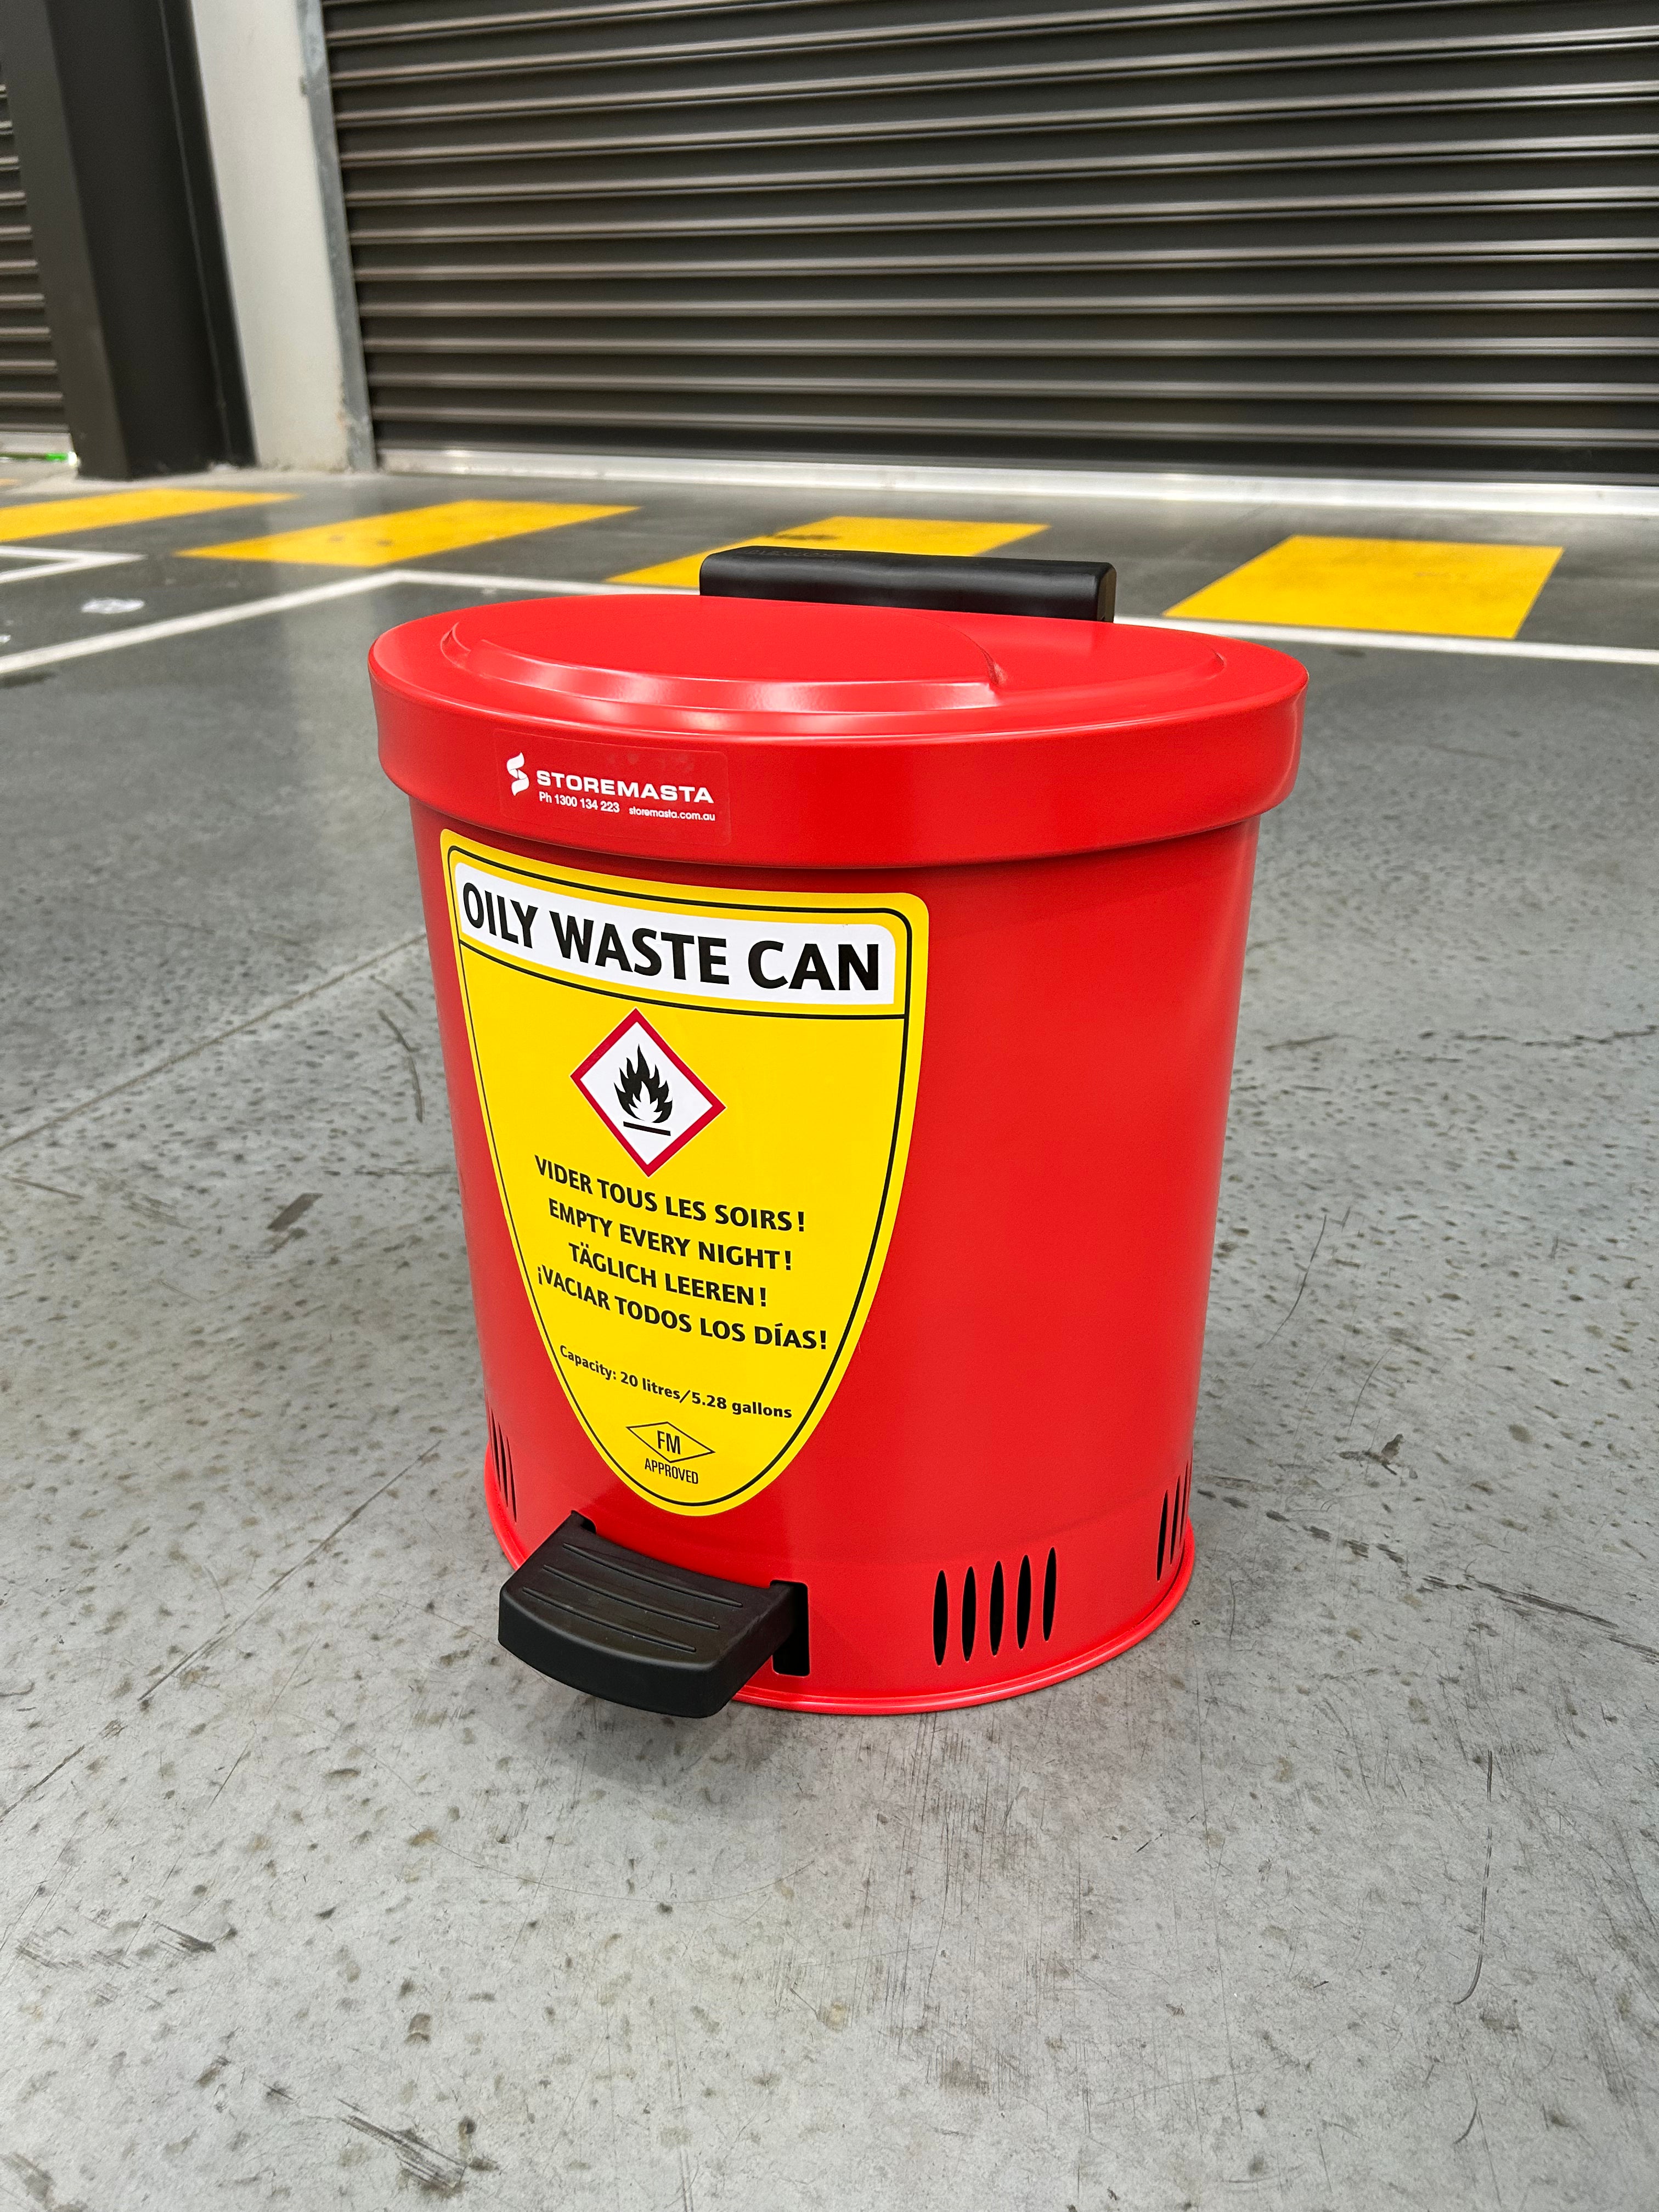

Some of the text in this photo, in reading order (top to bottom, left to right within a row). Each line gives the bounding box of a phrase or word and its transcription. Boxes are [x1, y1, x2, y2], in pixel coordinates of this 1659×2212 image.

[537, 771, 714, 803] STOREMASTA
[539, 792, 619, 812] Ph 1300 134 223
[629, 806, 715, 821] storemasta.com.au
[463, 883, 878, 990] OILY WASTE CAN
[535, 1155, 592, 1194] VIDER
[597, 1179, 657, 1211] TOUS
[666, 1196, 706, 1221] LES
[549, 1198, 612, 1237] EMPTY
[620, 1224, 690, 1256] EVERY
[569, 1242, 656, 1288] TÄGLICH
[538, 1265, 610, 1310] ¡VACIAR
[615, 1296, 691, 1332] TODOS
[701, 1318, 745, 1341] LOS
[561, 1345, 792, 1418] Capacity: 20 litres/5.28 gallons
[657, 1431, 680, 1454] FM
[645, 1458, 698, 1484] APPROVED
